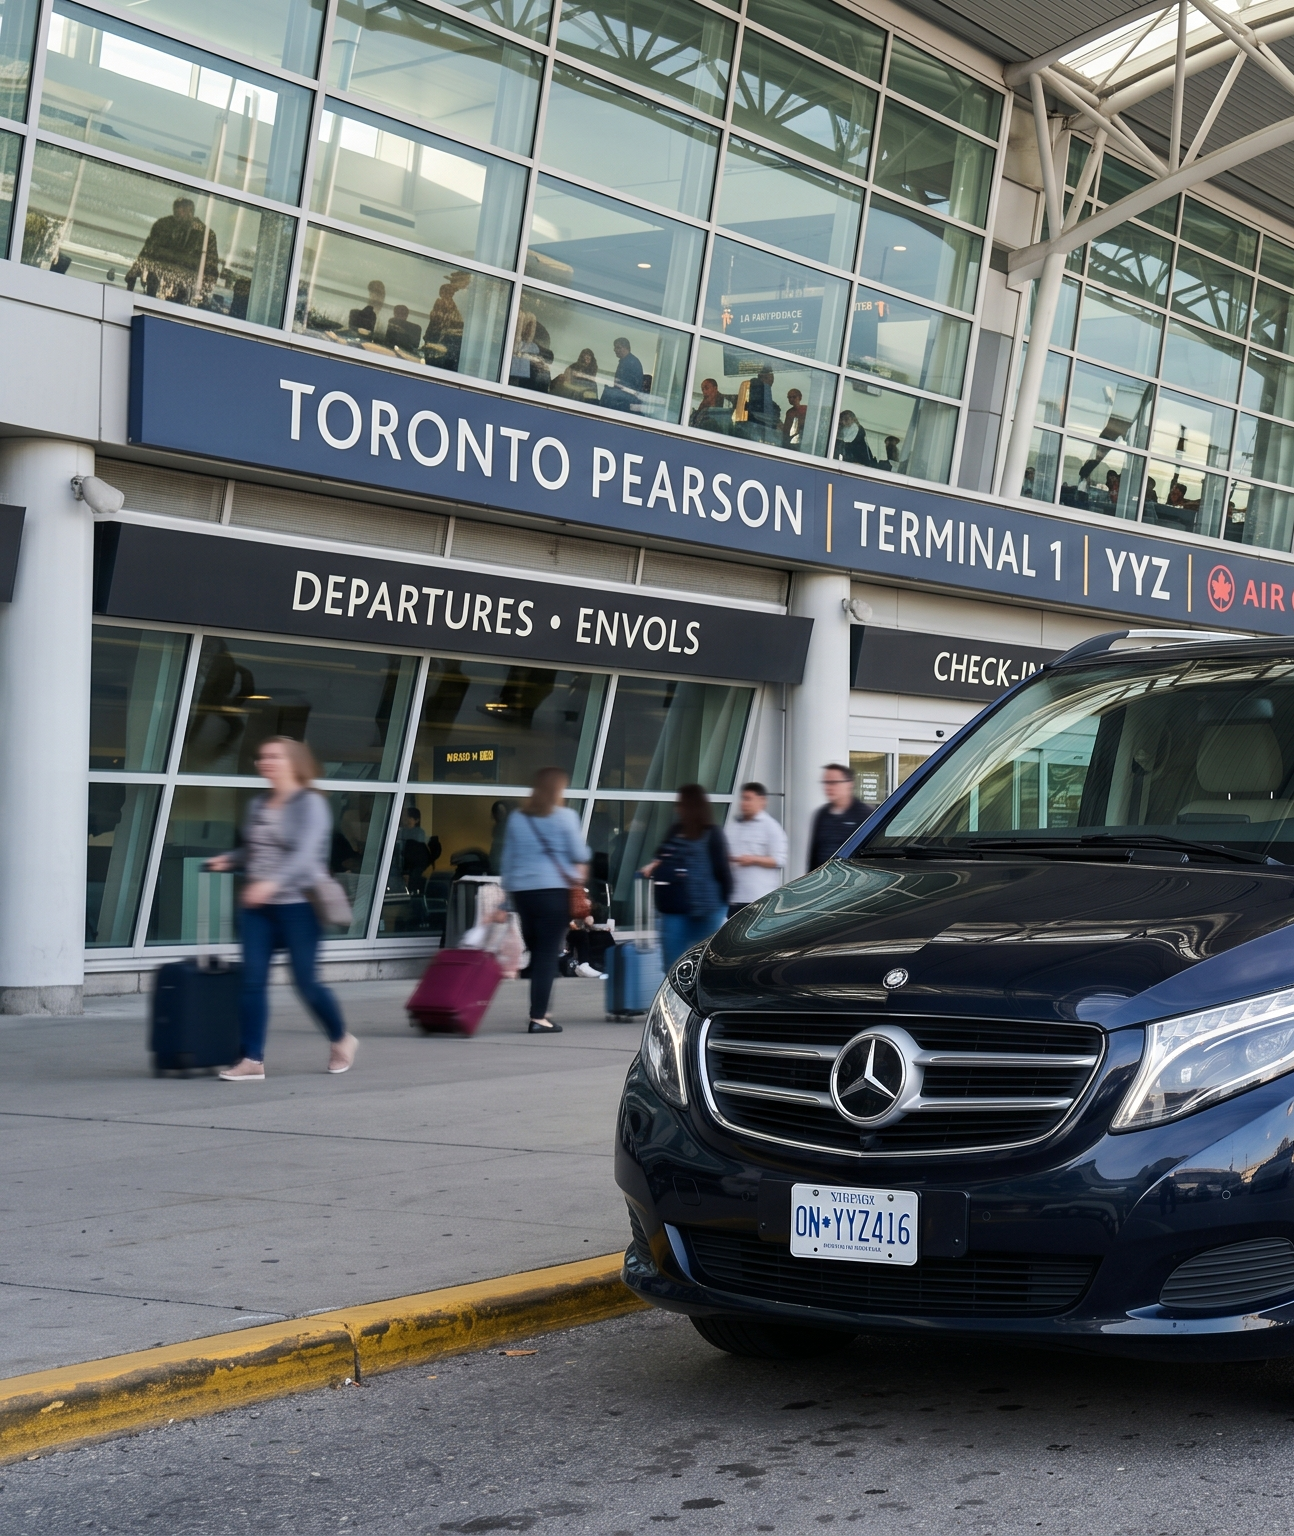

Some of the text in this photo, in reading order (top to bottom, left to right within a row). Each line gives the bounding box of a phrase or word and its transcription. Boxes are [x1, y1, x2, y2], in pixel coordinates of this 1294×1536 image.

[279, 379, 570, 491] TORONTO
[592, 446, 804, 536] PEARSON
[853, 501, 1036, 578] TERMINAL
[1050, 541, 1062, 582] 1
[1105, 547, 1171, 601] YYZ
[1243, 580, 1285, 611] AIR
[292, 571, 700, 655] DEPARTURES ENVOLS
